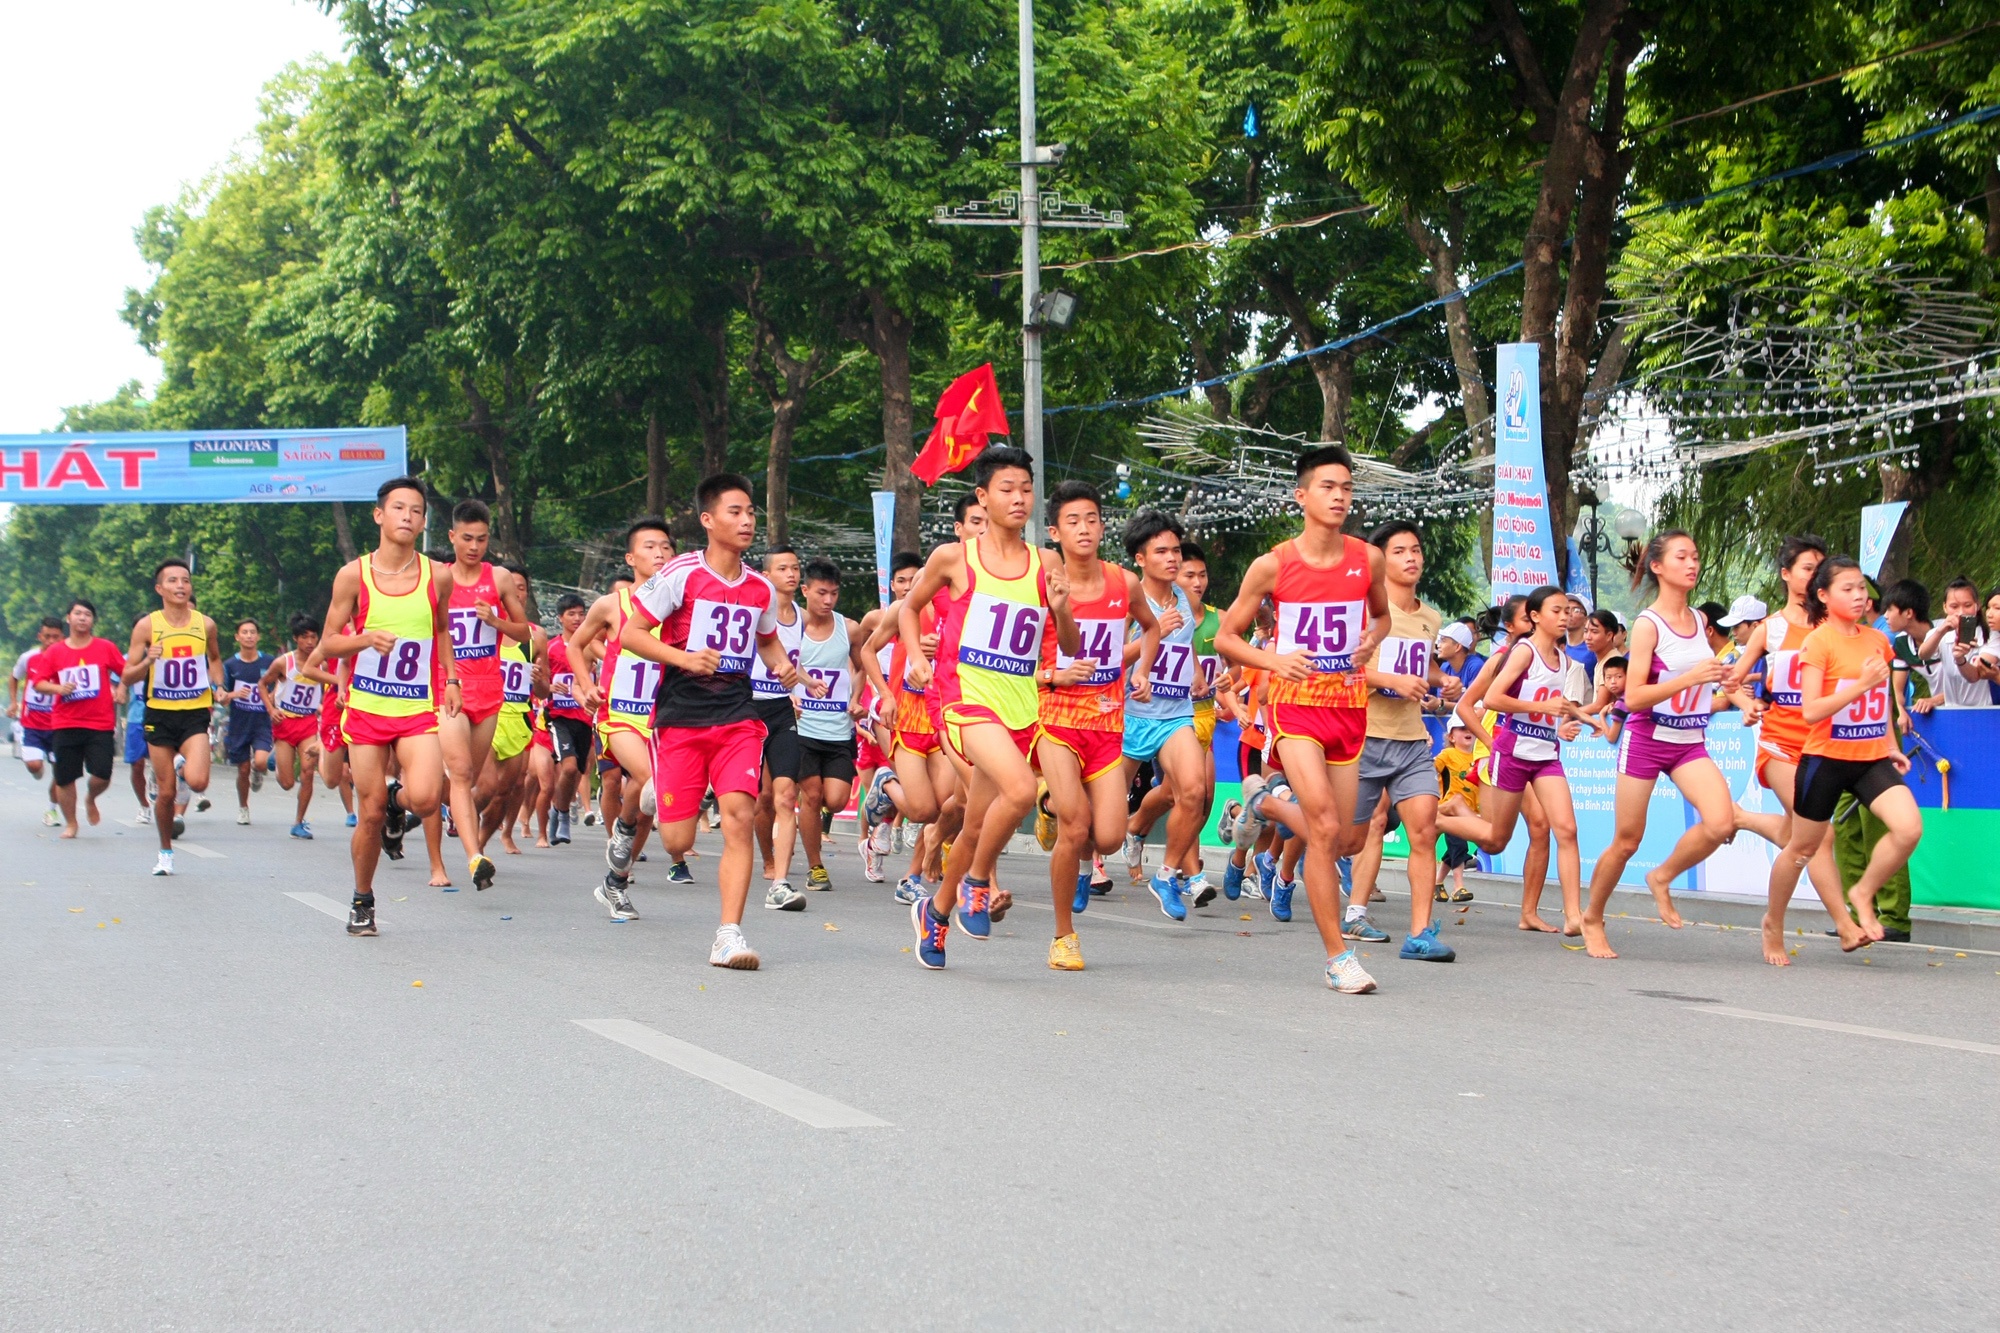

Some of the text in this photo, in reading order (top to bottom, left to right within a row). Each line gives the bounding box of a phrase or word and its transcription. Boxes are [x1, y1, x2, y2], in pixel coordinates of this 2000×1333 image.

[194, 439, 271, 452] SALONPAS
[1494, 487, 1506, 505] ÁO
[1529, 547, 1542, 559] 42
[1523, 569, 1548, 585] BÌNH
[449, 611, 483, 646] 57
[705, 605, 752, 655] 33
[988, 602, 1040, 656] 16
[1294, 605, 1347, 653] 45
[377, 641, 421, 682] 18
[719, 658, 746, 671] ONPAS
[967, 651, 1030, 674] SALONPAS
[1150, 643, 1190, 683] 47
[1312, 659, 1351, 670] ONPAS
[1394, 641, 1426, 678] 46
[163, 659, 198, 689] 06
[157, 688, 203, 700] SALONPAS
[290, 684, 315, 707] 58
[359, 678, 421, 698] SALONPAS
[617, 701, 653, 714] SALON
[1848, 679, 1888, 723] 55
[1657, 715, 1708, 729] SALONPAS
[1729, 737, 1742, 751] bộ
[1565, 746, 1617, 762] Tôi yêu cuộc
[1579, 767, 1592, 778] hân
[1575, 783, 1593, 797] chạy
[1659, 787, 1677, 800] rộng
[1601, 801, 1615, 811] 201
